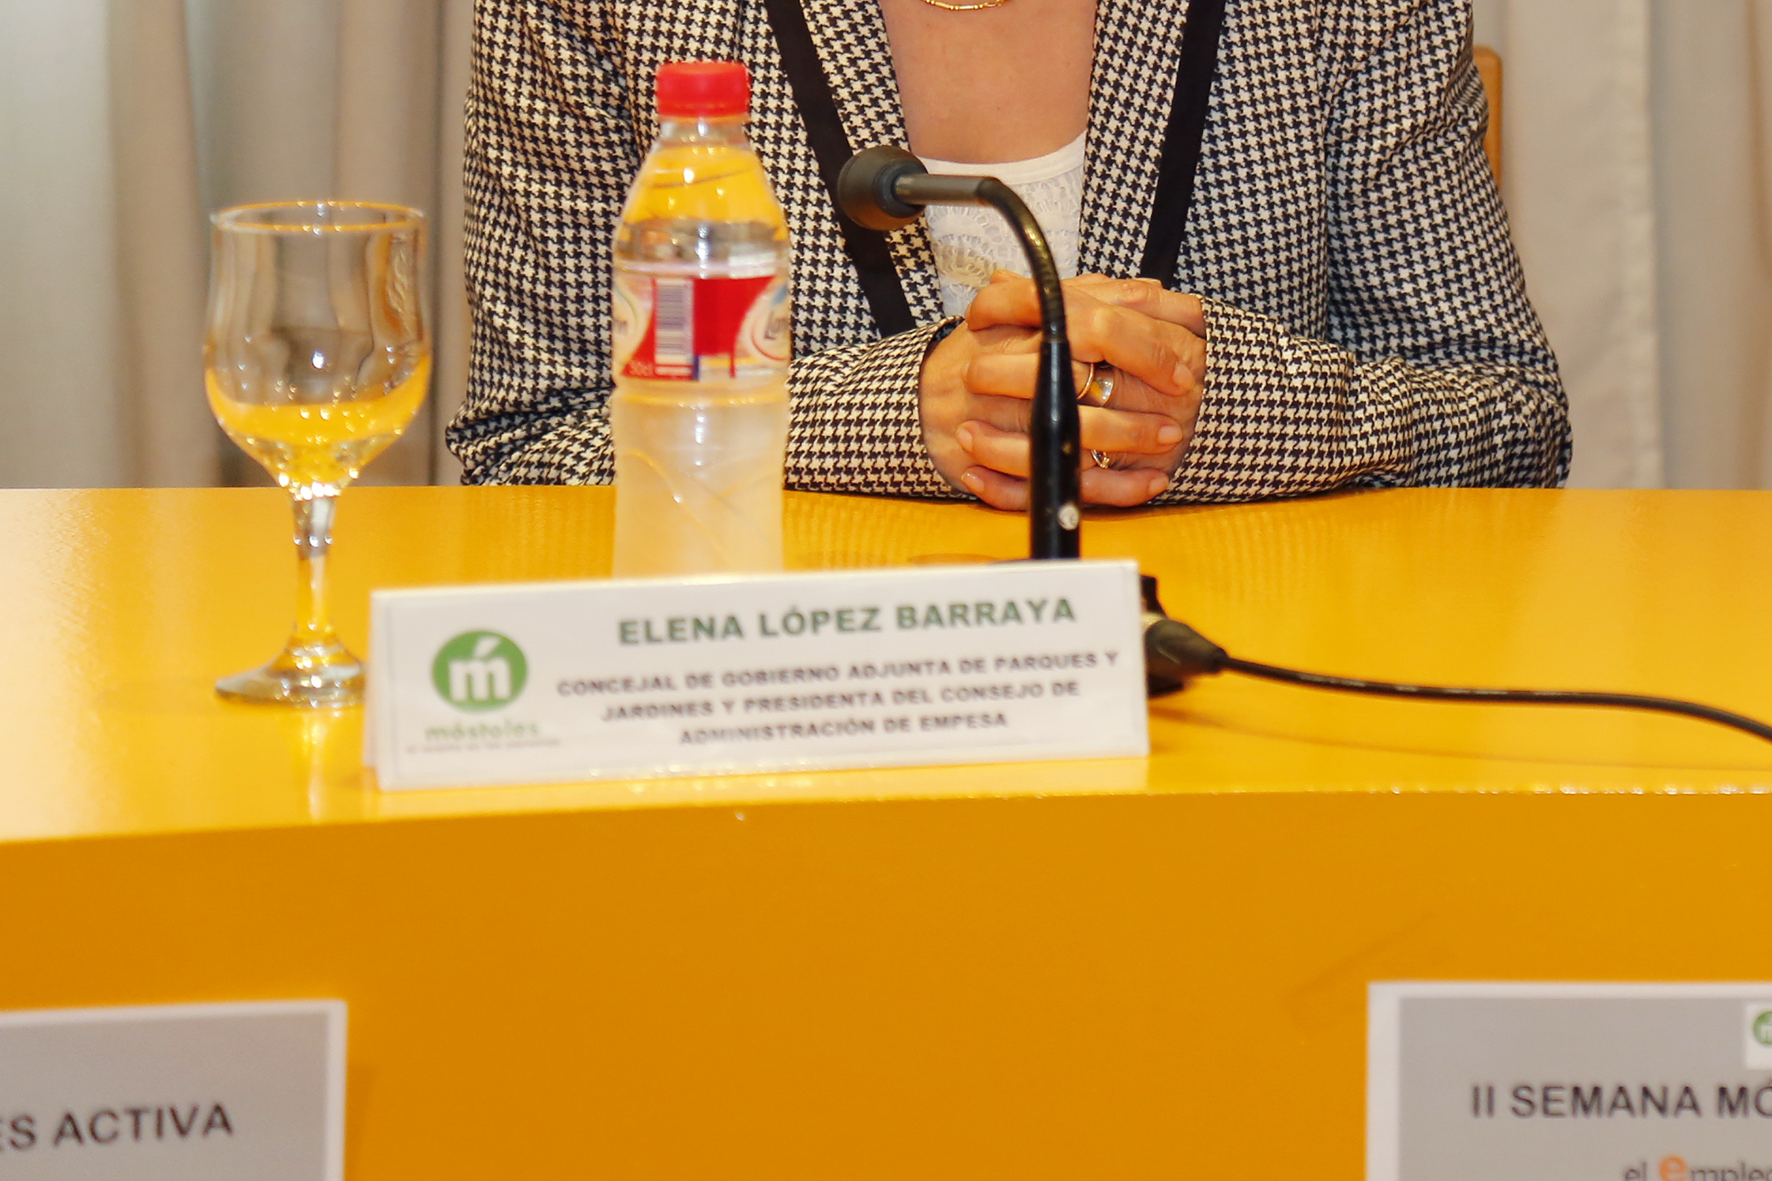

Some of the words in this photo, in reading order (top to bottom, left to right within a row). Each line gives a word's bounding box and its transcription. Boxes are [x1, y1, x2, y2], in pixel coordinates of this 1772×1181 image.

[618, 615, 744, 645] ELENA
[758, 603, 881, 637] LÓPEZ
[896, 598, 1076, 630] BARRAYA
[557, 674, 676, 696] CONCEJAL
[685, 672, 714, 689] DE
[722, 666, 840, 688] GOBIERNO
[848, 660, 951, 680] ADJUNTA
[959, 658, 986, 674] DE
[994, 652, 1098, 671] PARQUES
[1104, 650, 1119, 666] Y
[602, 701, 714, 721] JARDINES
[722, 700, 736, 715] Y
[743, 691, 885, 714] PRESIDENTA
[892, 688, 933, 705] DEL
[941, 683, 1044, 703] CONSEJO
[1051, 680, 1079, 697] DE
[680, 717, 875, 744] ADMINISTRACIÓN
[884, 717, 911, 733] DE
[920, 712, 1008, 731] EMPESA
[1472, 1085, 1496, 1118] II
[1511, 1085, 1702, 1118] SEMANA
[53, 1102, 234, 1147] ACTIVA
